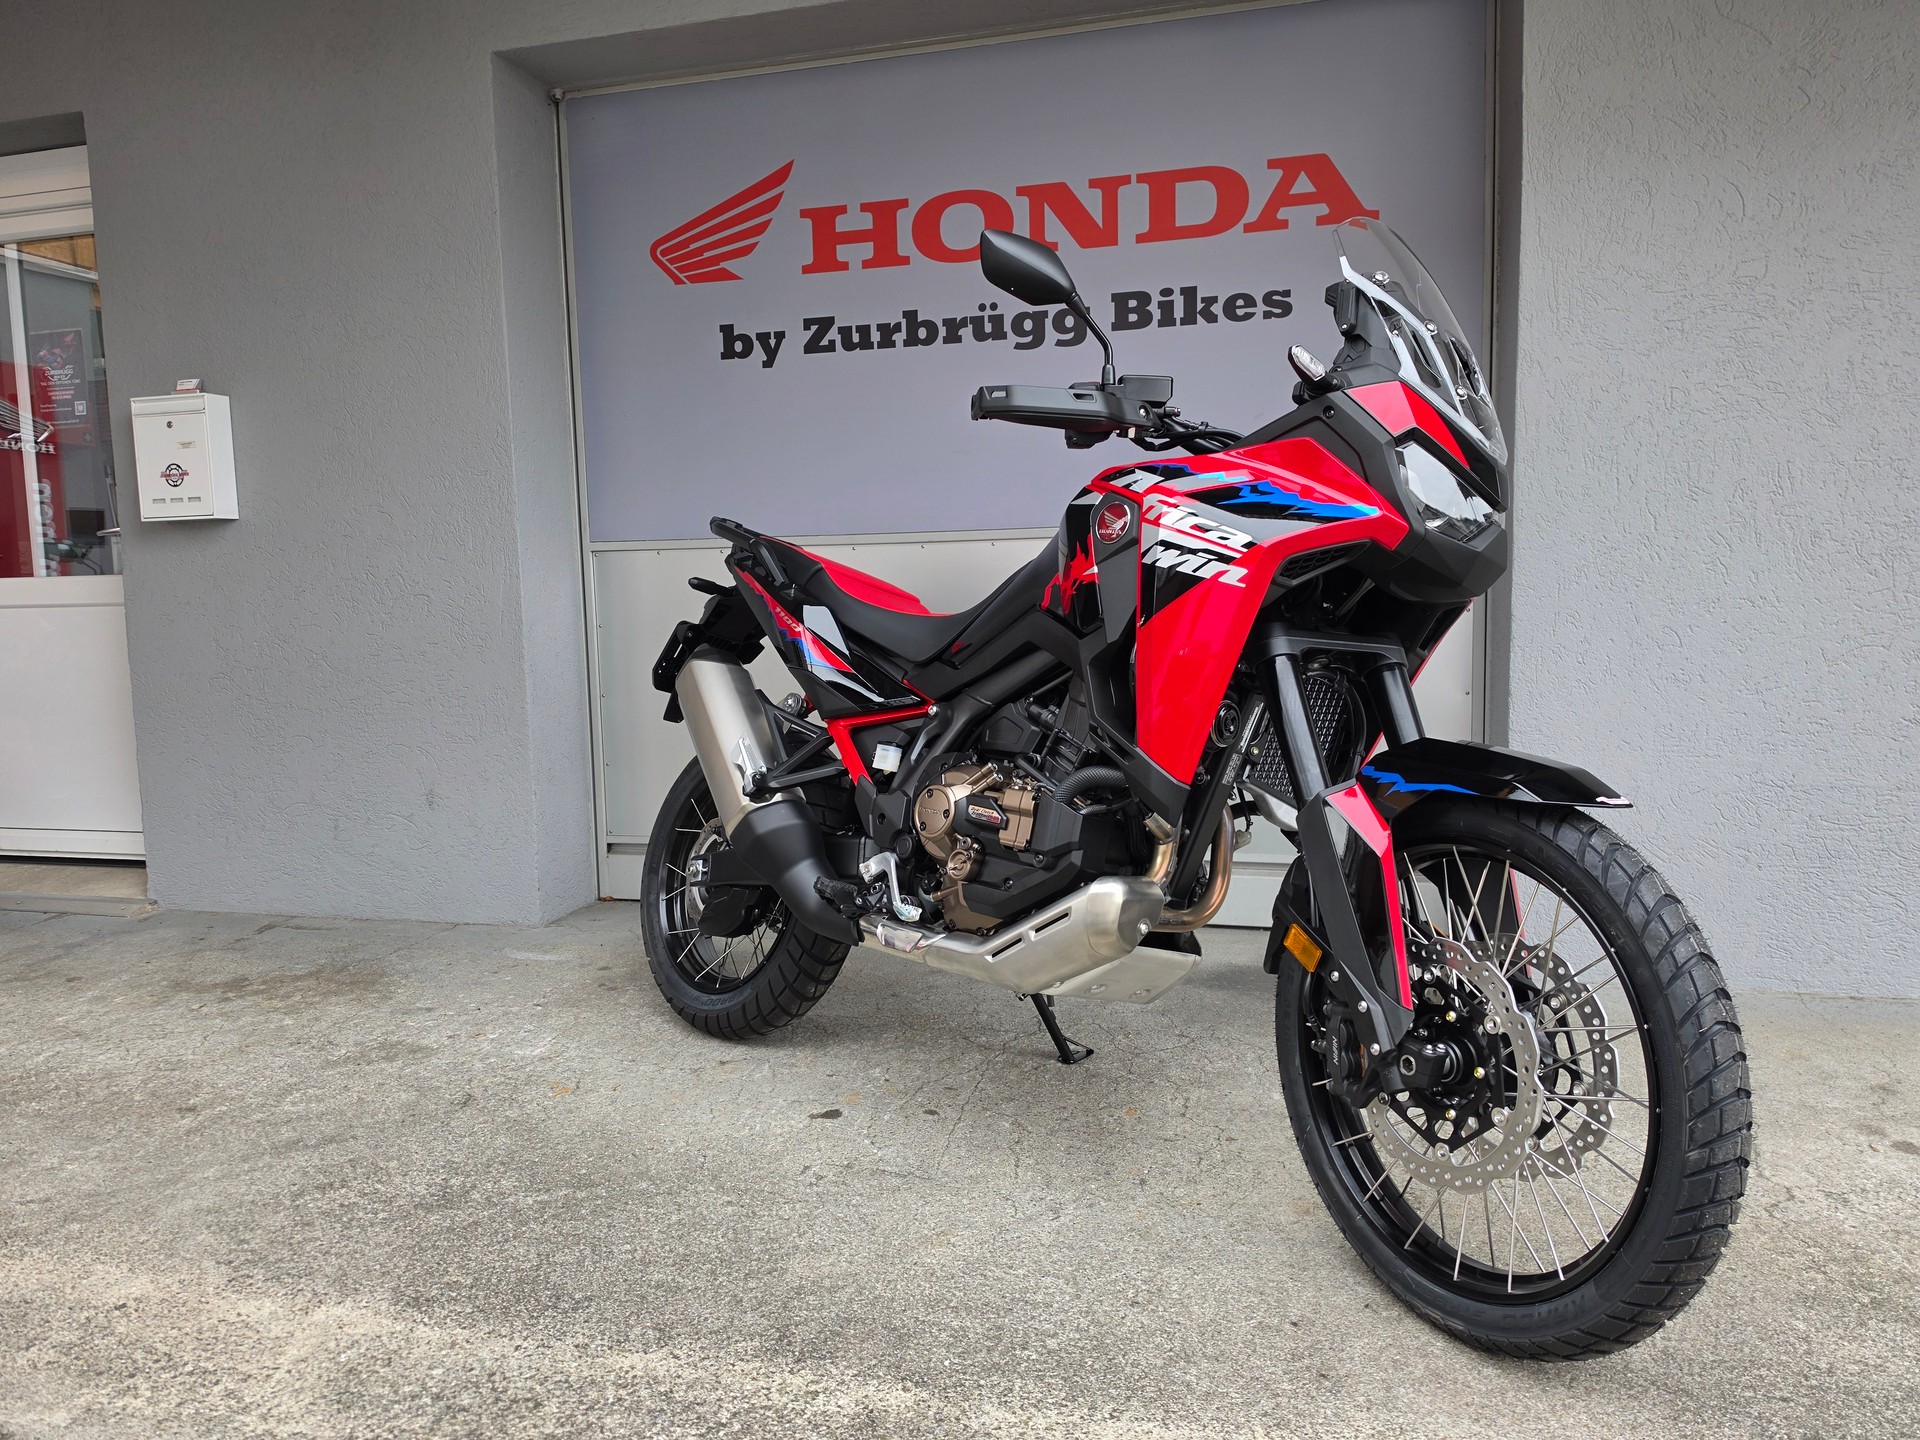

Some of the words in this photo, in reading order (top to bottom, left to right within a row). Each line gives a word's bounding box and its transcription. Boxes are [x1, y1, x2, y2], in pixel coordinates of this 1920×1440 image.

[800, 152, 1380, 274] HONDA
[719, 323, 786, 369] by
[803, 302, 1091, 355] Zurbrügg
[1111, 285, 1294, 332] Bikes
